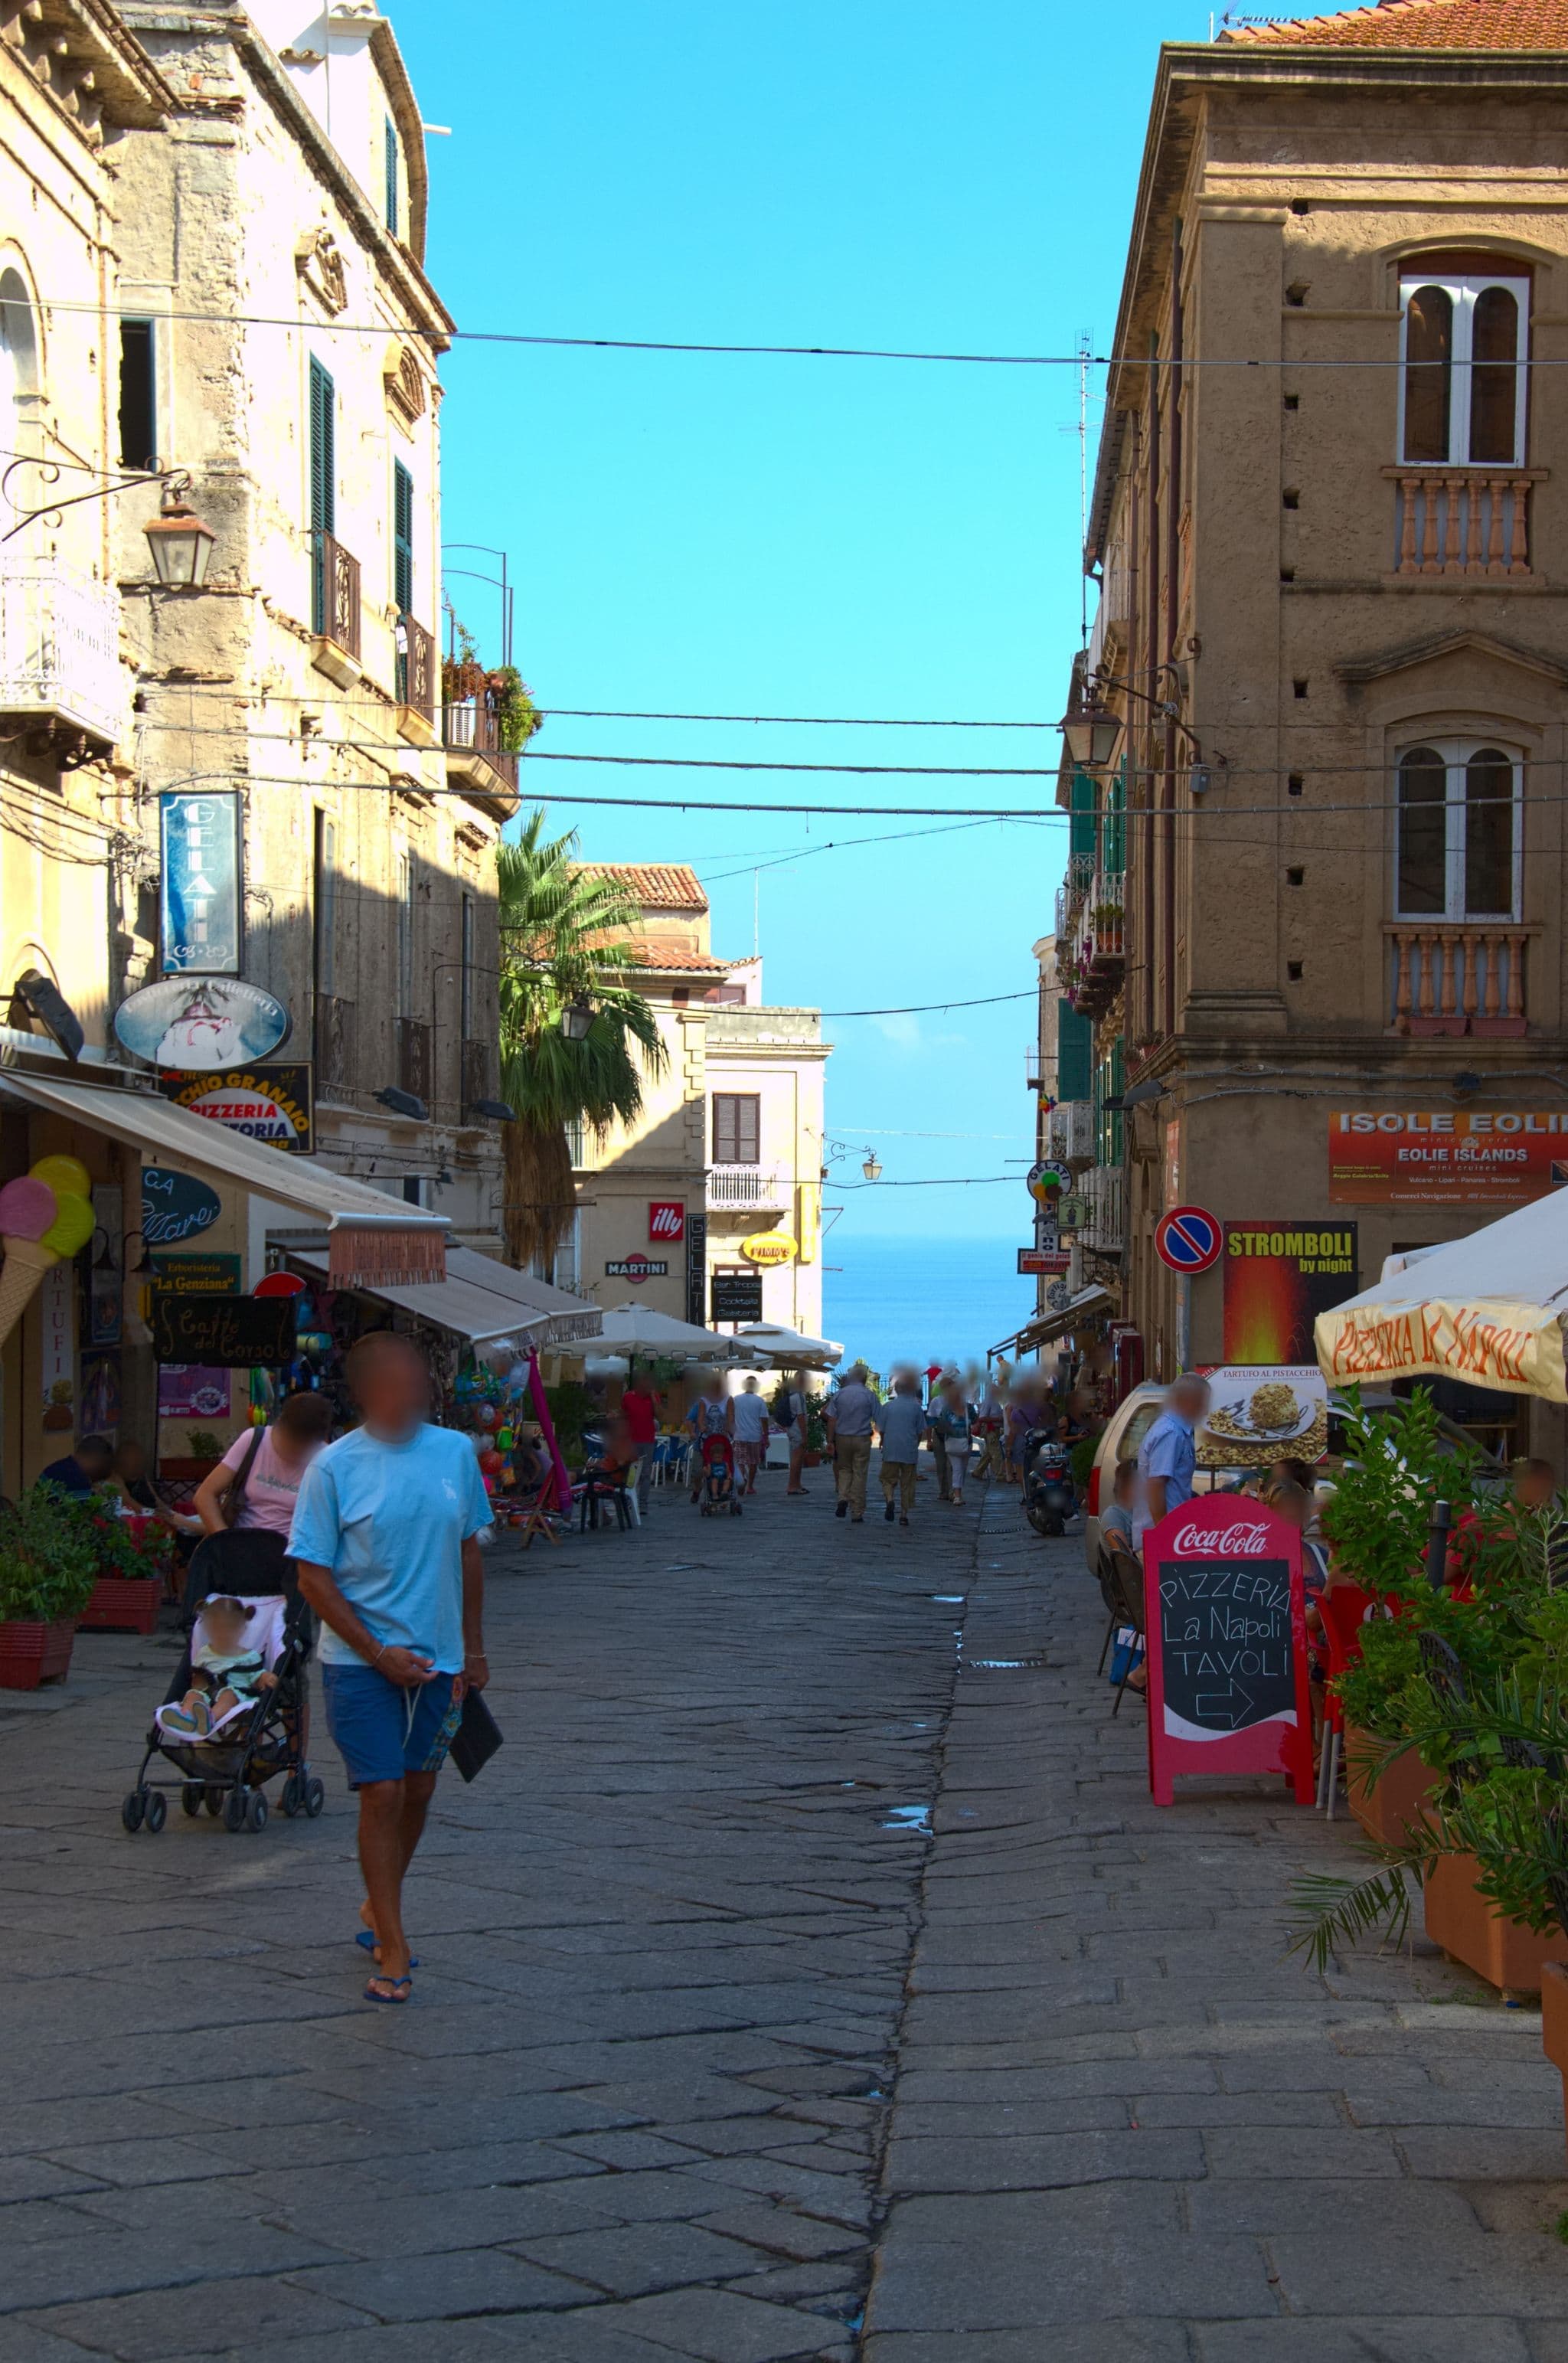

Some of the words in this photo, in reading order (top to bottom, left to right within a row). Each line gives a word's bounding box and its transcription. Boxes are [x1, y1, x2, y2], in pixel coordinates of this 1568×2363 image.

[183, 802, 217, 942] GELATI
[188, 1103, 277, 1118] PIZZERIA
[226, 1073, 309, 1132] GRANAIO
[1341, 1113, 1455, 1133] ISOLE
[1469, 1113, 1568, 1133] EOLI
[1398, 1148, 1449, 1162] EOLIE
[1454, 1148, 1529, 1162] ISLANDS
[1030, 1162, 1069, 1180] GELATI
[1439, 1176, 1455, 1185] Lipari
[1422, 1192, 1462, 1201] Navigazione
[652, 1208, 683, 1237] illy
[1228, 1232, 1351, 1257] STROMBOLI
[167, 1263, 220, 1272] Erboristeria
[608, 1263, 665, 1274] MARTINI
[691, 1217, 704, 1326] GELATI
[1298, 1258, 1315, 1273] by
[1318, 1258, 1353, 1273] night
[1332, 1314, 1416, 1376] PIZZERIA
[1173, 1522, 1272, 1555] Coca-Cola
[1164, 1612, 1200, 1642] La
[1210, 1605, 1280, 1646] Napoli
